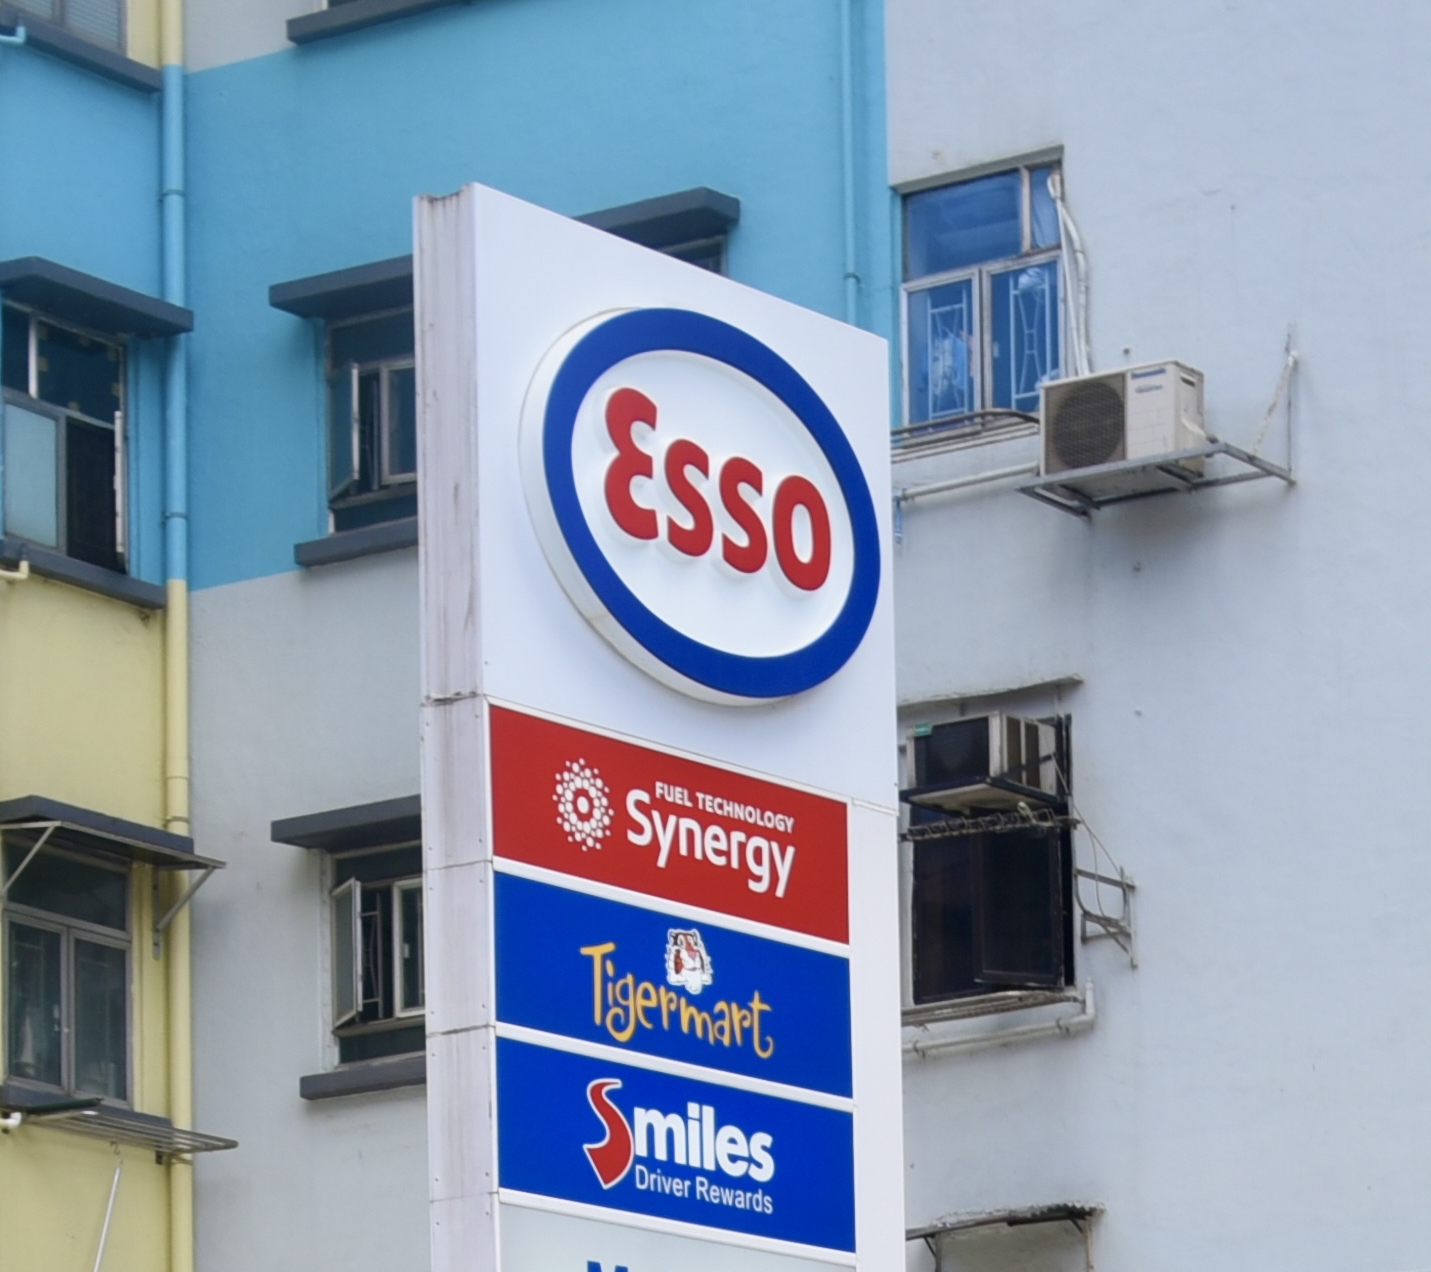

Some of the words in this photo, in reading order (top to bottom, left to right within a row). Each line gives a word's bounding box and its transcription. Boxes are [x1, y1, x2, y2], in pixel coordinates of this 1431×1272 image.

[626, 789, 795, 899] Synergy
[654, 781, 693, 808] FUEL
[696, 791, 795, 834] TECHNOLOGY
[580, 941, 774, 1059] Tigermart
[582, 1078, 775, 1189] Smiles
[634, 1164, 691, 1200] Driver
[695, 1177, 774, 1214] Rewards
